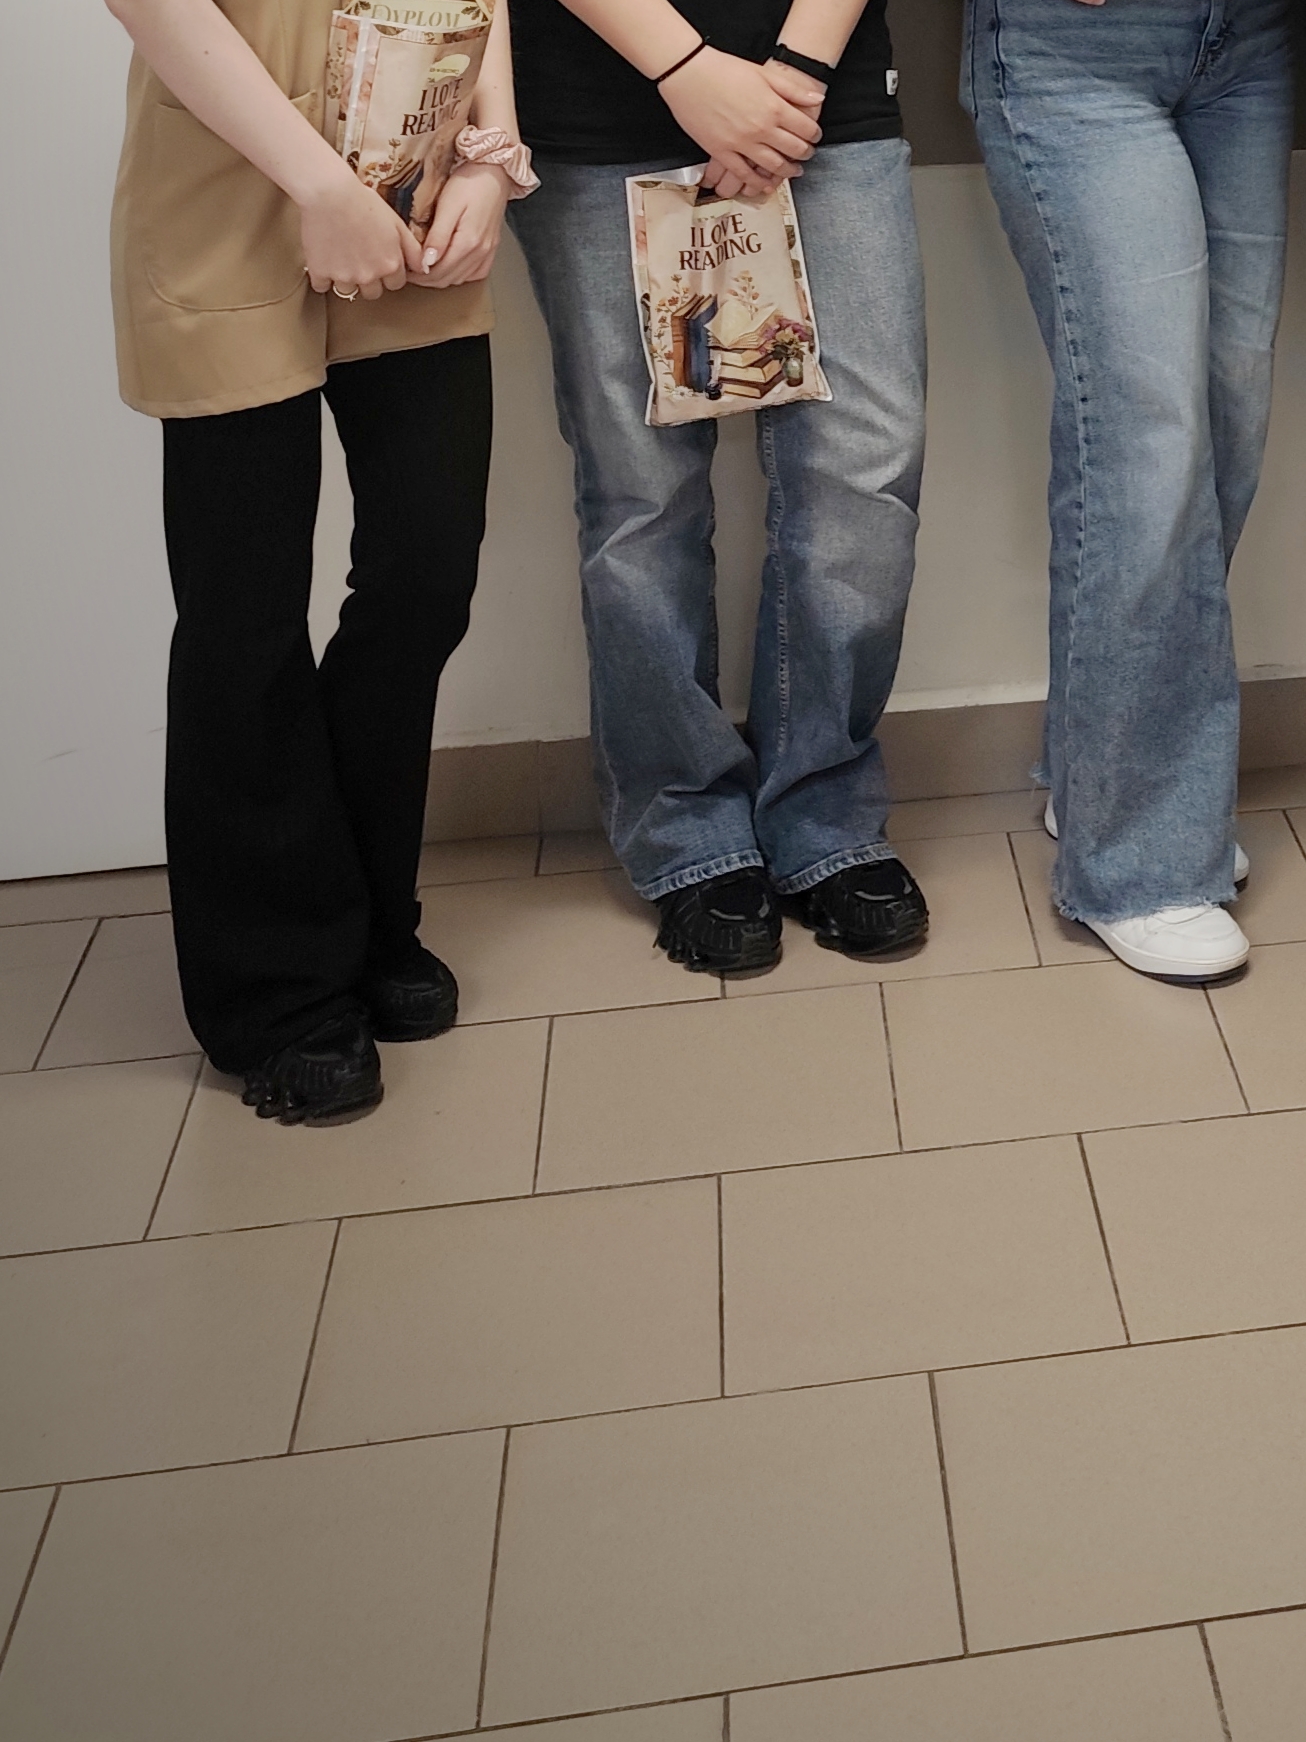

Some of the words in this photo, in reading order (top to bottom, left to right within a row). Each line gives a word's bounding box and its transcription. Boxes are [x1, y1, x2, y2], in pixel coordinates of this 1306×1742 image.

[371, 3, 461, 27] DYPLOM
[419, 90, 427, 110] I
[690, 227, 695, 247] I
[700, 213, 746, 247] LOVE
[679, 233, 762, 270] READING
